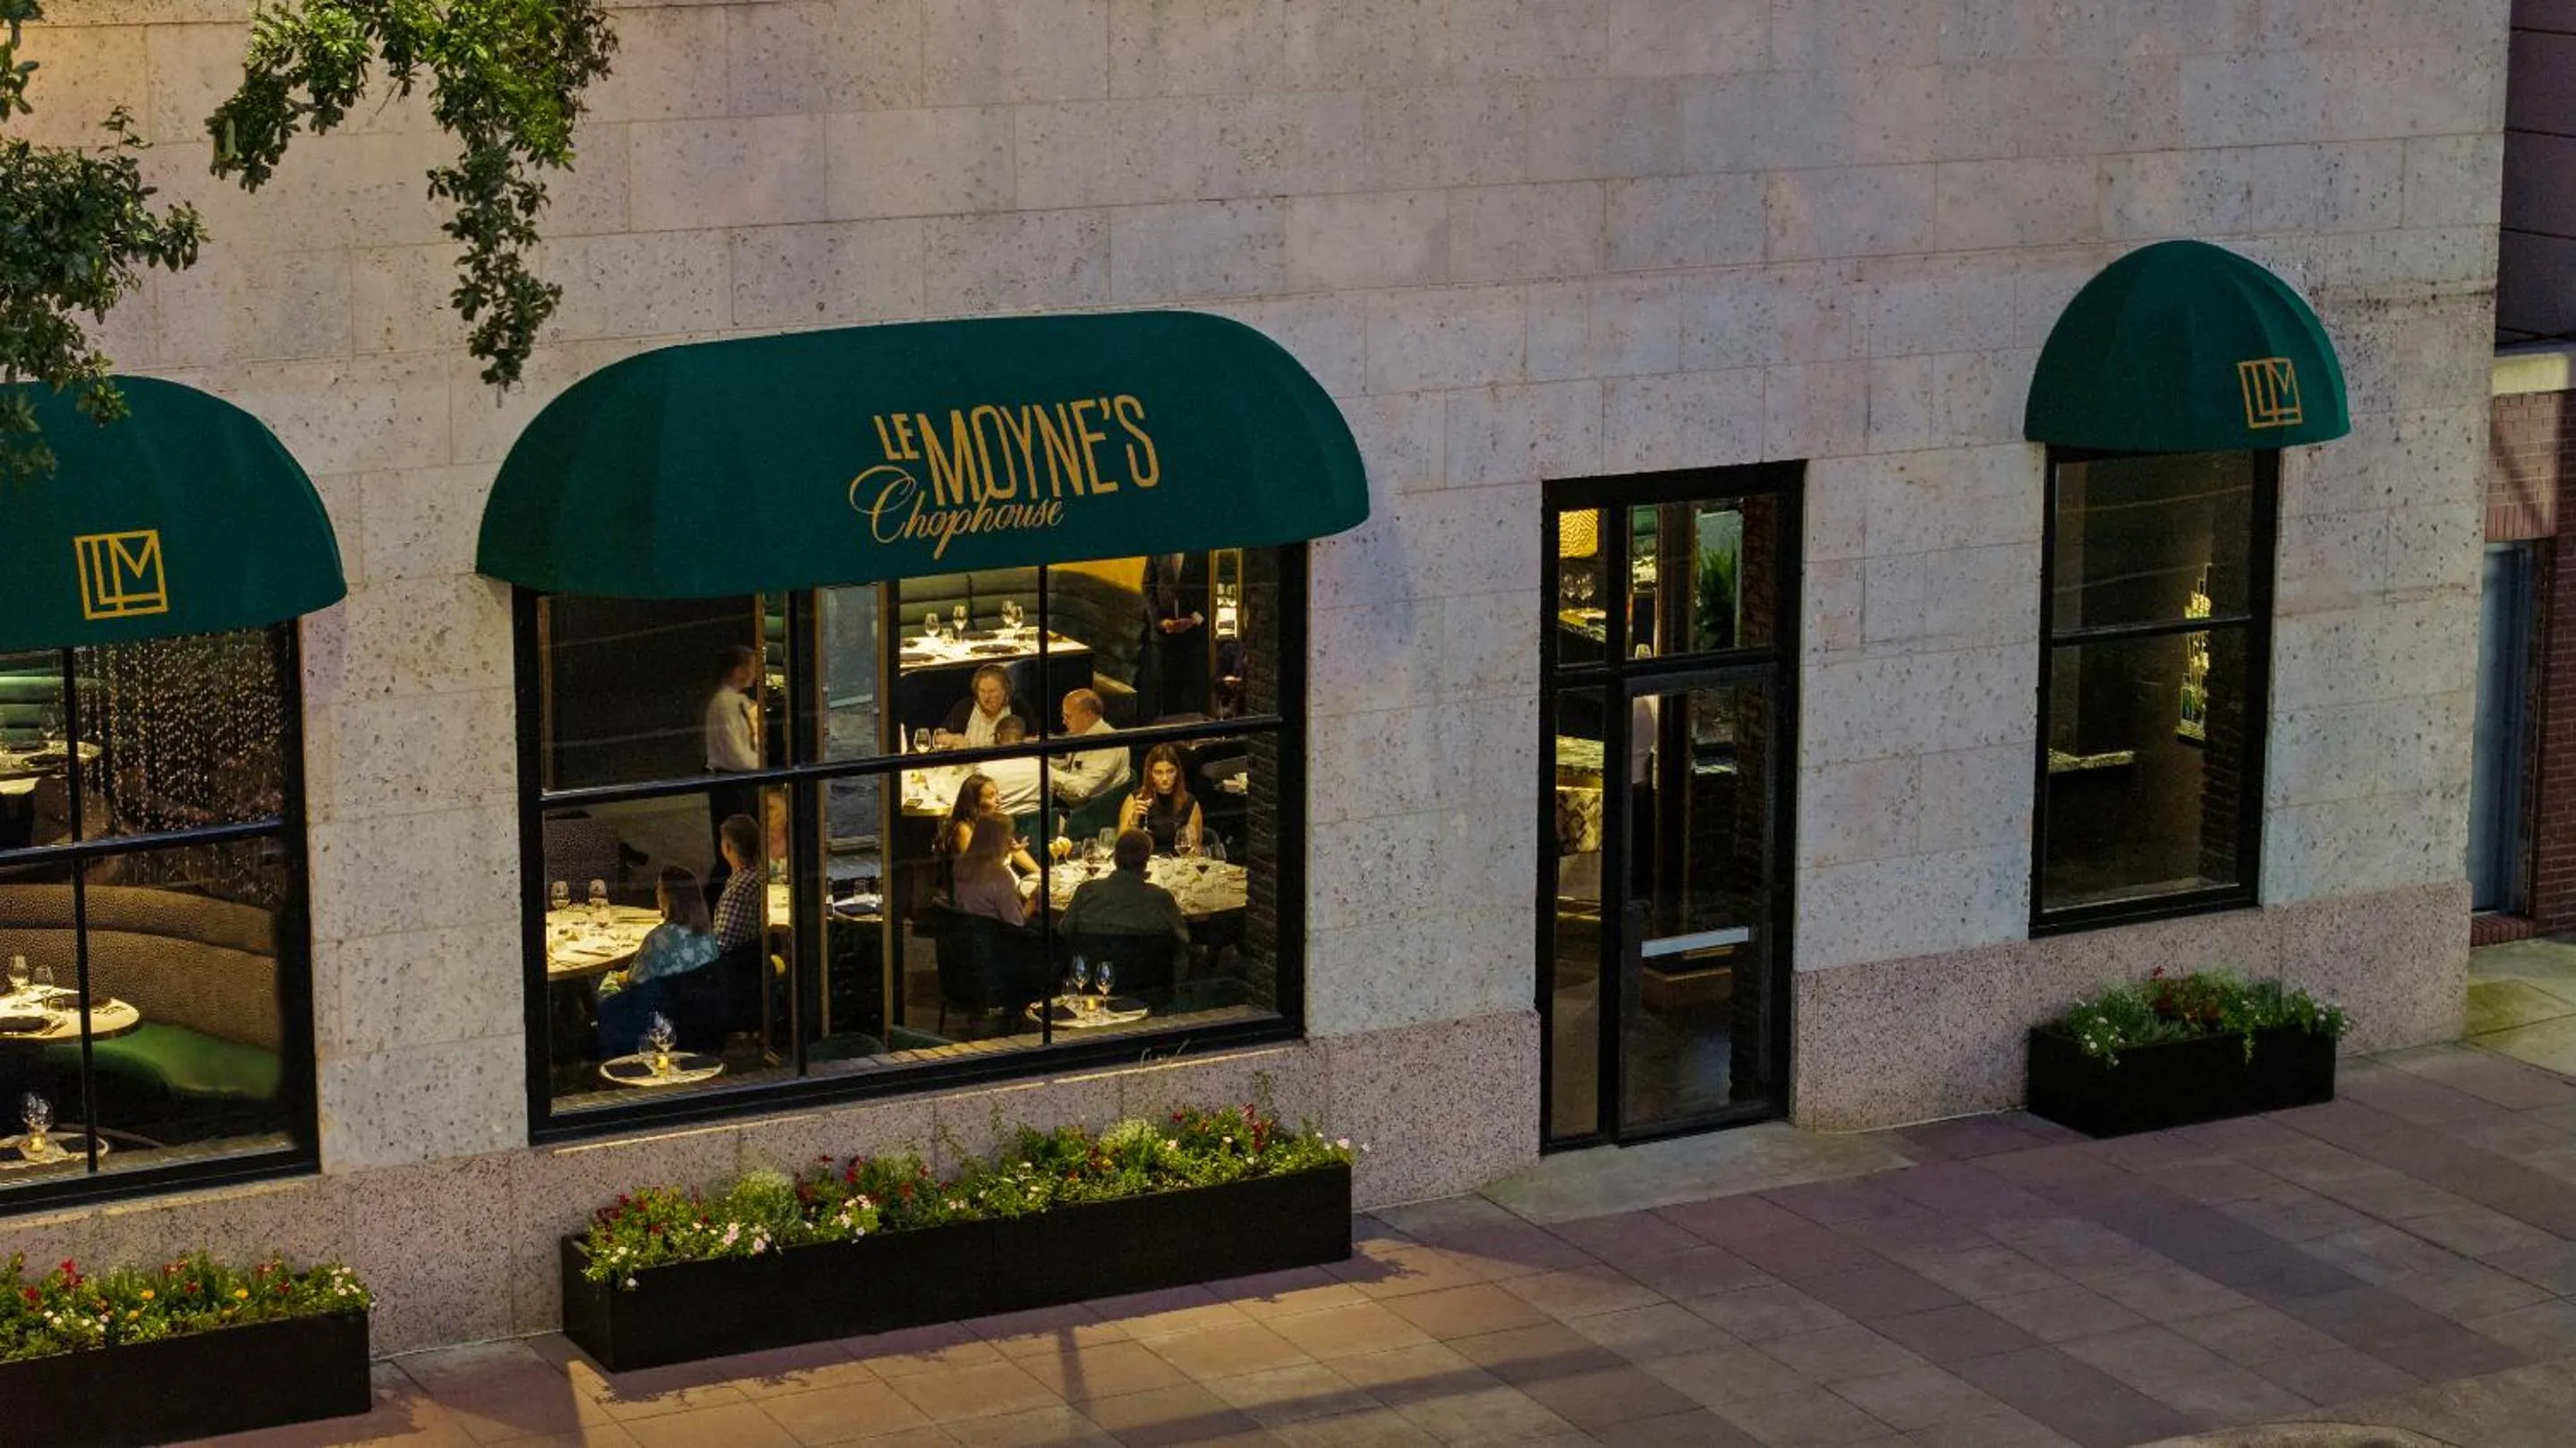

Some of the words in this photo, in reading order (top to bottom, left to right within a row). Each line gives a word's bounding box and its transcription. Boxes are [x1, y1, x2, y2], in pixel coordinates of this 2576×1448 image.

[873, 413, 921, 460] LE
[915, 394, 1160, 506] MOYNE'S
[849, 464, 1064, 561] Chophouse
